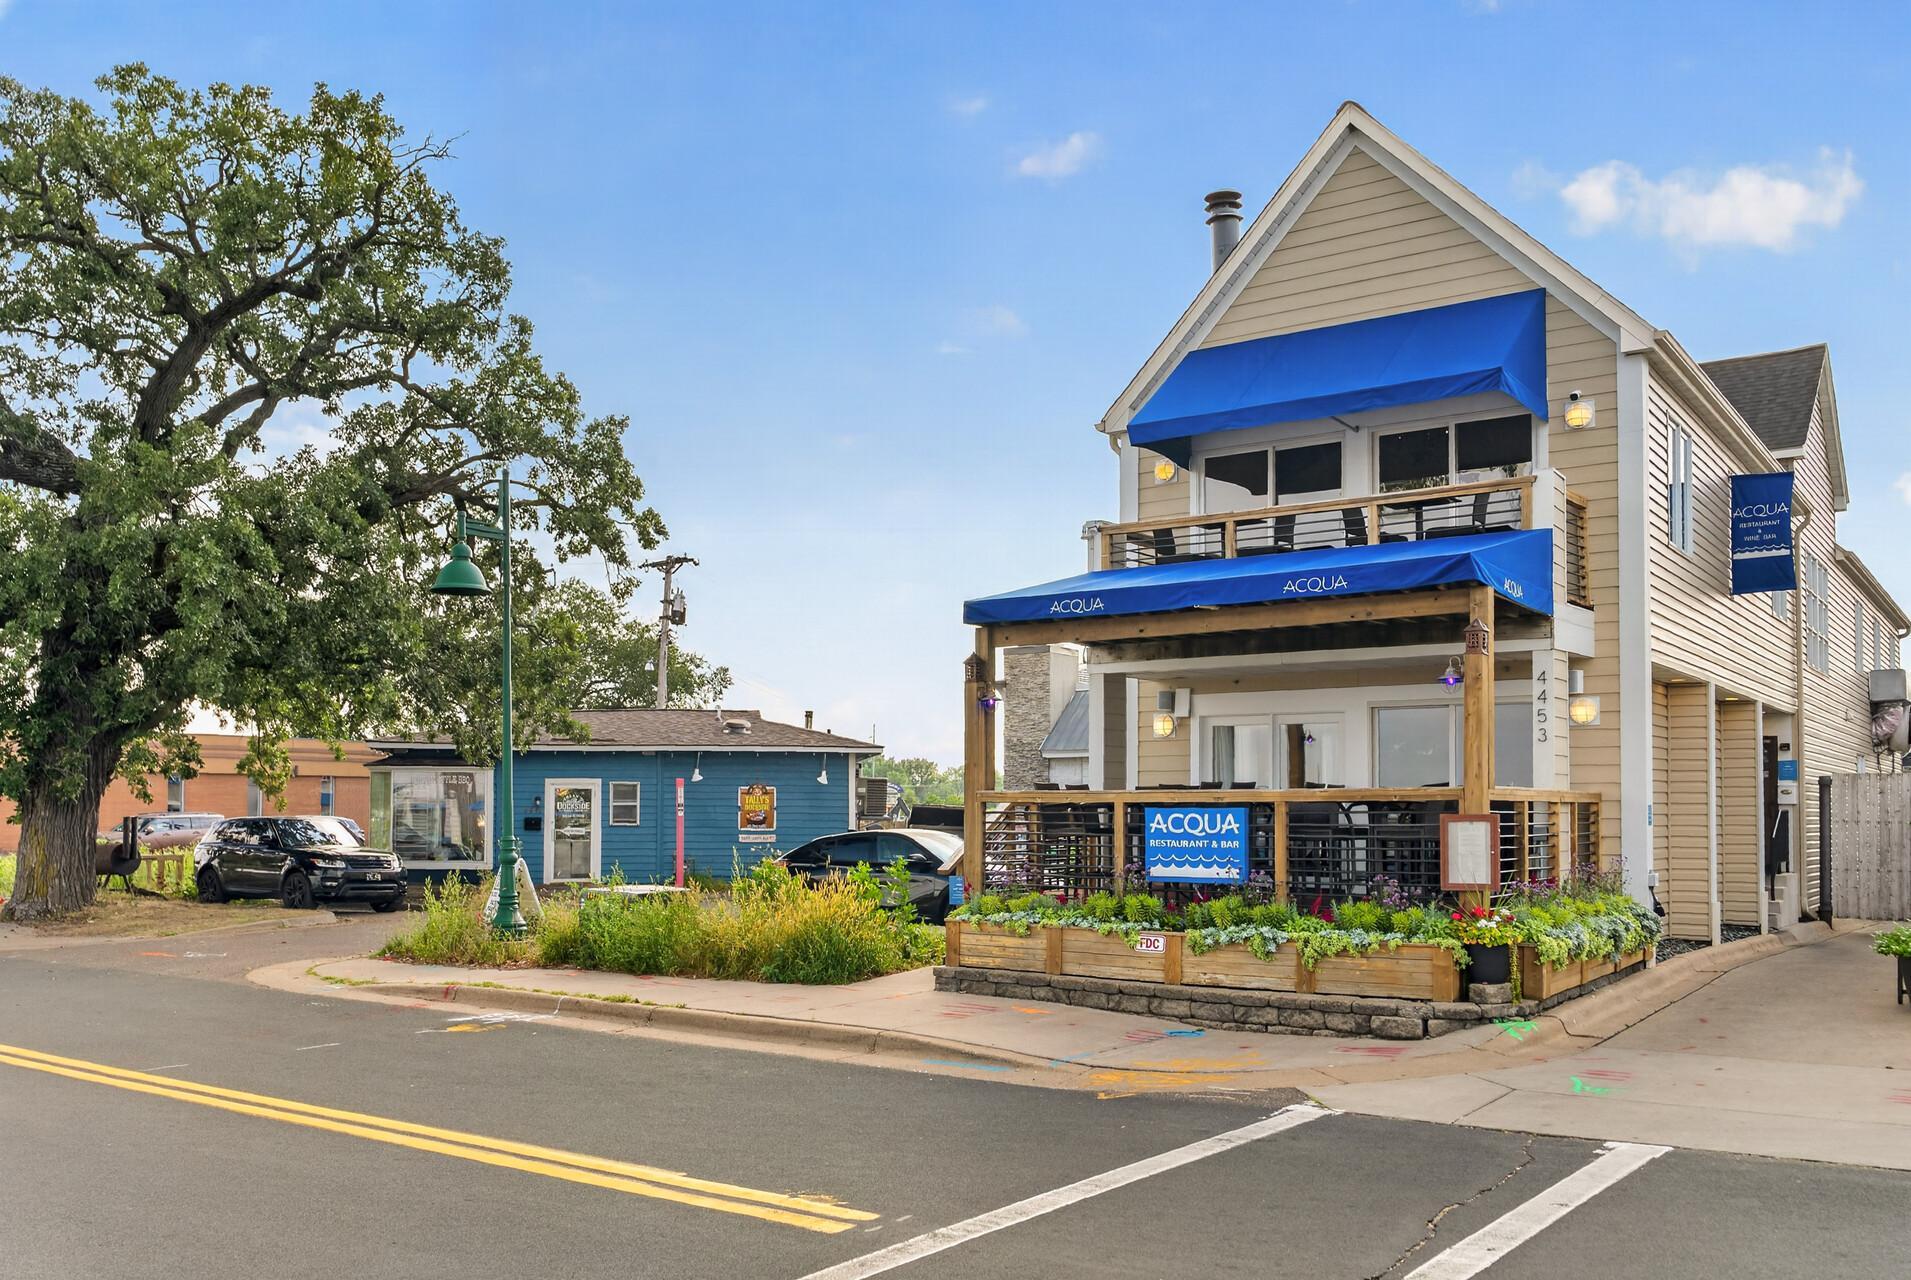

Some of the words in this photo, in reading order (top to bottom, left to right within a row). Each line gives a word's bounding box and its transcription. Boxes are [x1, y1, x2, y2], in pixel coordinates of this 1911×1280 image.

[1733, 502, 1790, 518] ACQUA
[1739, 519, 1780, 528] RESTAURANT
[1283, 575, 1348, 594] ACQUA
[1503, 577, 1523, 599] ACQUA
[1050, 597, 1104, 614] ACQUA
[1537, 670, 1547, 742] 4453
[557, 801, 591, 810] DOCKSIDE
[1150, 813, 1240, 837] ACQUA
[1150, 839, 1209, 848] RESTAURANT
[1211, 840, 1218, 848] &
[1221, 840, 1239, 848] BAR
[1140, 937, 1160, 949] FDC
